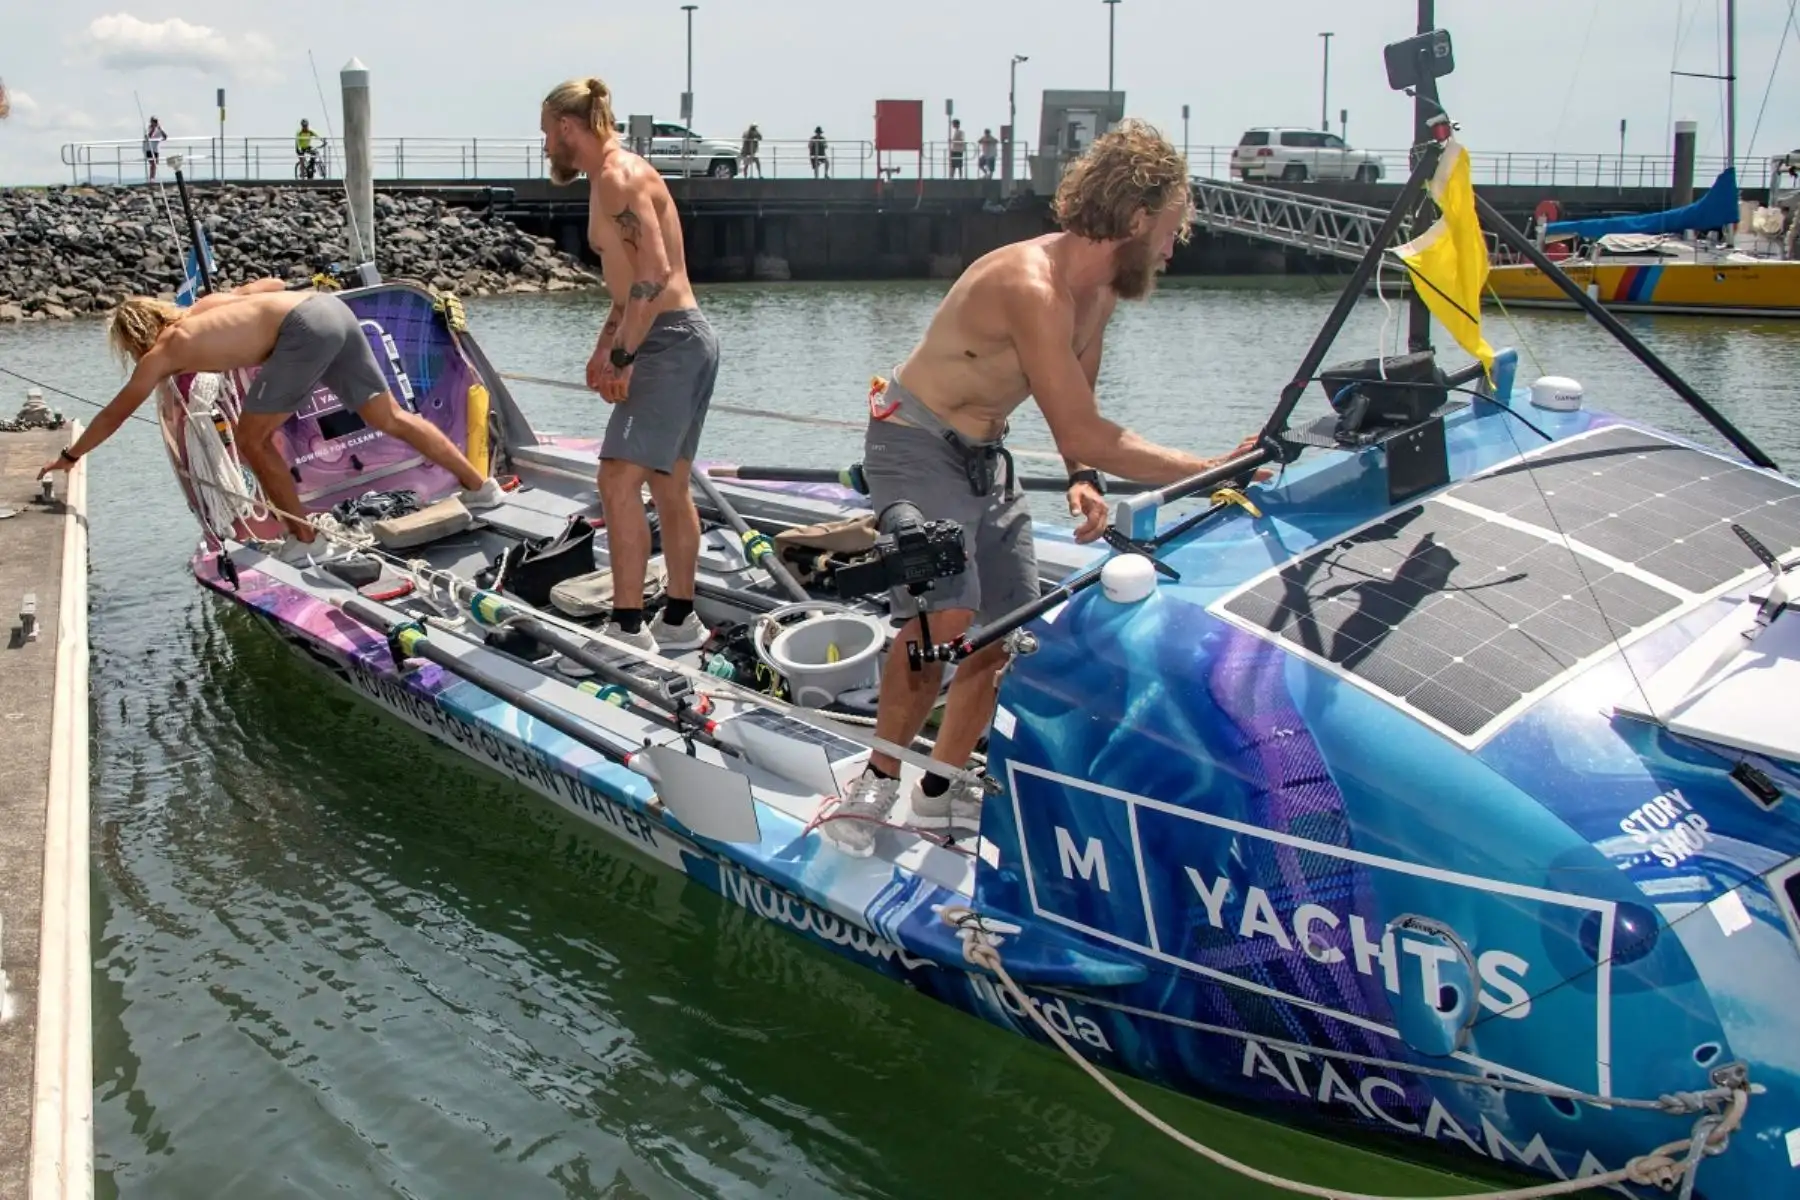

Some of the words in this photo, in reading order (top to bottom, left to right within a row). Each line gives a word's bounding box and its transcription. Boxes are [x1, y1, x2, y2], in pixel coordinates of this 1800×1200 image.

[295, 448, 329, 464] ROWING
[330, 442, 347, 454] FOR
[347, 433, 374, 448] CLEAN
[354, 663, 433, 726] ROWING
[432, 703, 481, 752] FOR
[480, 729, 561, 796] CLEAN
[559, 771, 659, 848] WATER
[1619, 788, 1694, 844] STORY
[1651, 813, 1714, 868] SHOP
[1054, 826, 1111, 893] M
[1184, 865, 1532, 1020] YACHTS
